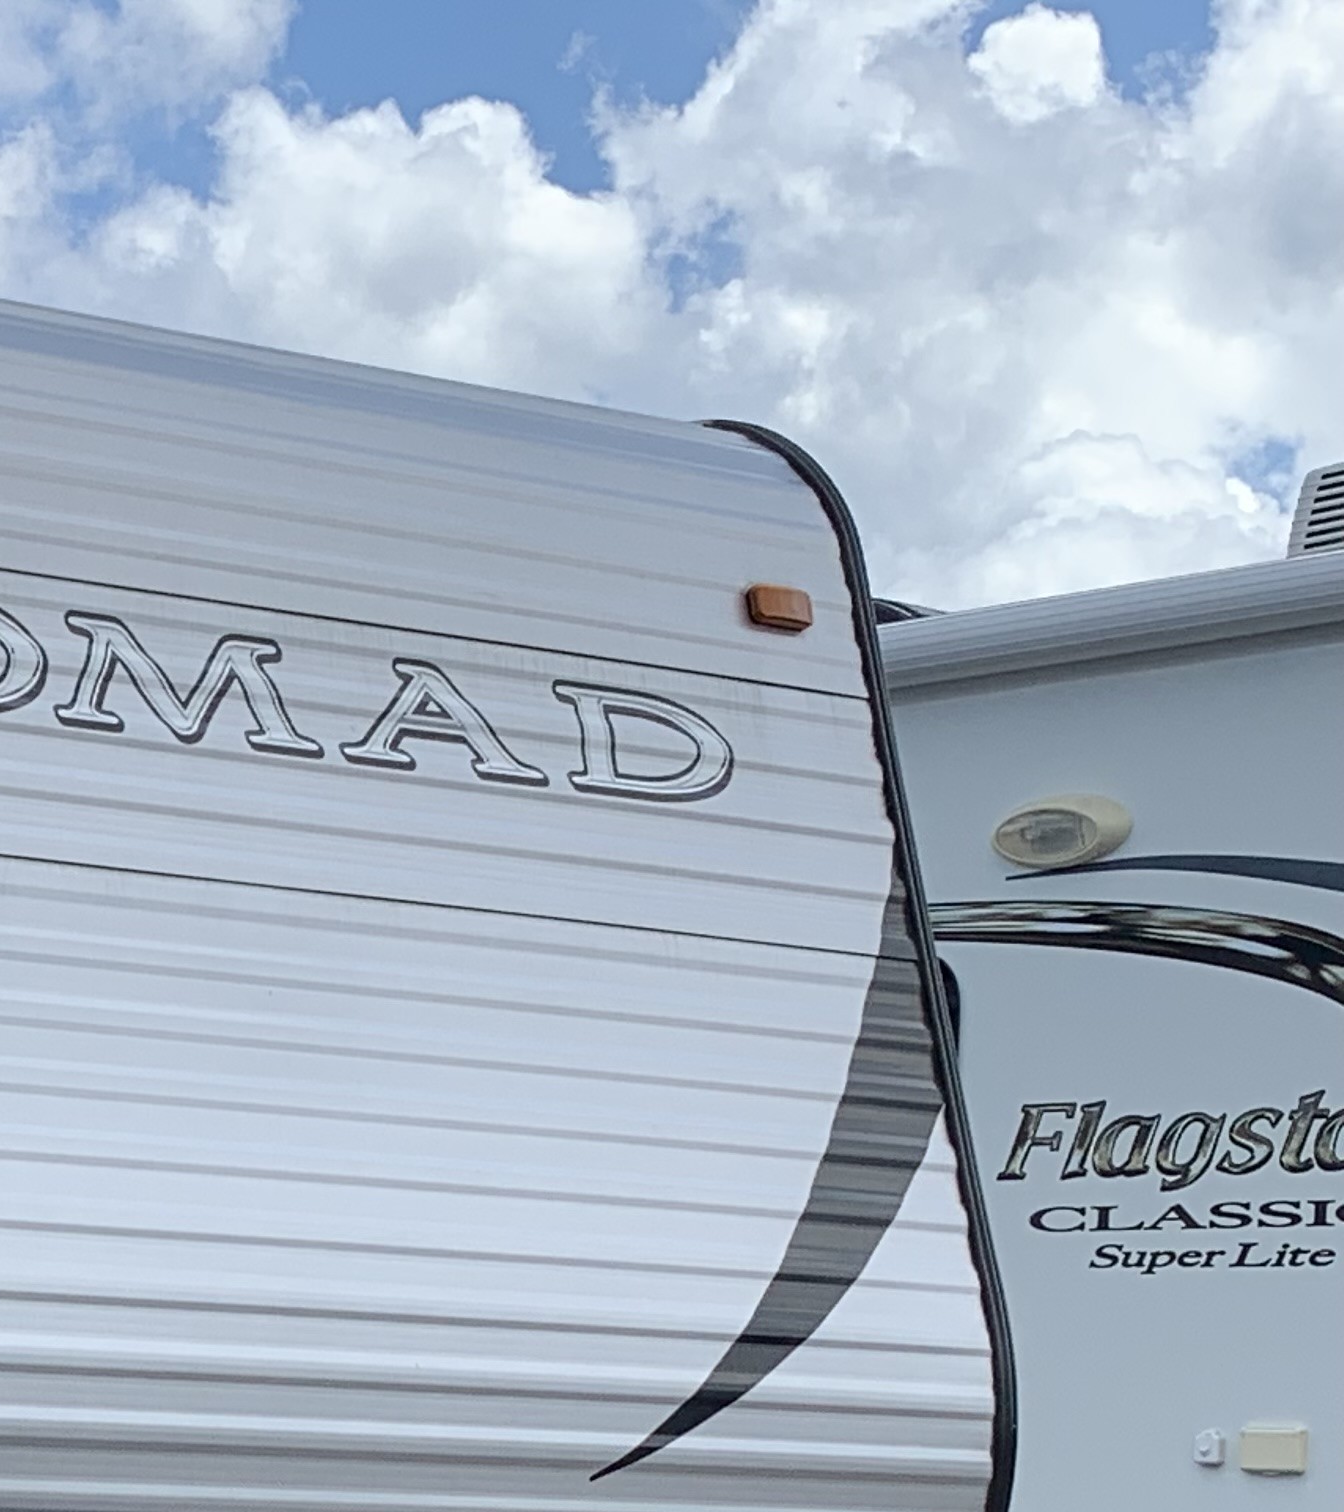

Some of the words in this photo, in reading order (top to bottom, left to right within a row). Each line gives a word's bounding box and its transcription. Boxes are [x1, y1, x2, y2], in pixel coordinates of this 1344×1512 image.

[1029, 1199, 1344, 1233] CLASSI
[1089, 1243, 1226, 1275] Super
[1229, 1242, 1337, 1268] Lite
